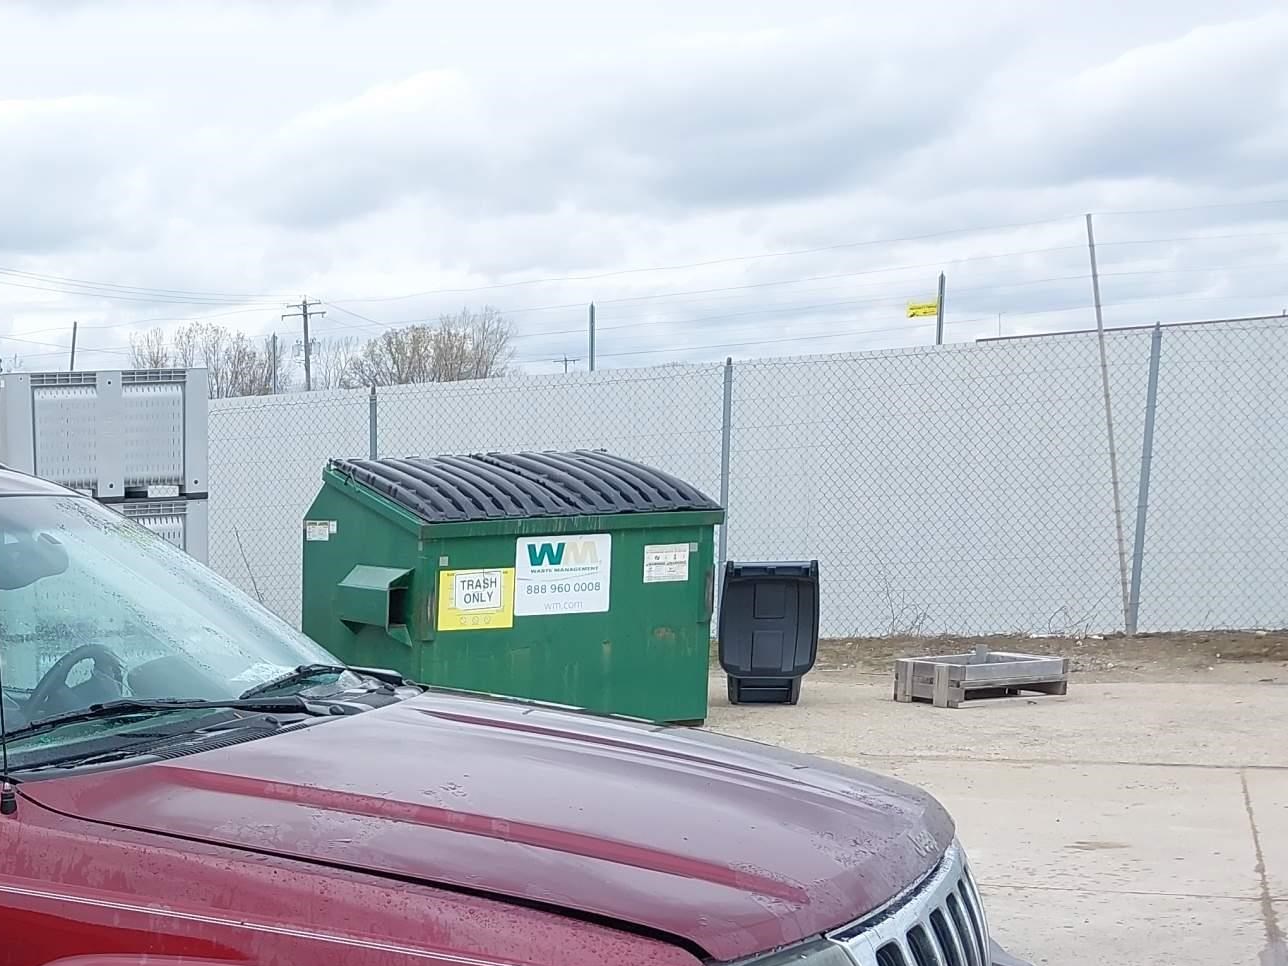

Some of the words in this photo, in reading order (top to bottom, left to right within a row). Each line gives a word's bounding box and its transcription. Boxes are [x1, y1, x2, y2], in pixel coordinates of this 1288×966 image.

[527, 541, 598, 567] WM
[460, 577, 497, 591] TRASH
[526, 584, 547, 595] 888
[550, 583, 571, 593] 960
[574, 581, 601, 592] 0008
[463, 591, 494, 604] ONLY
[543, 600, 583, 610] wm.com
